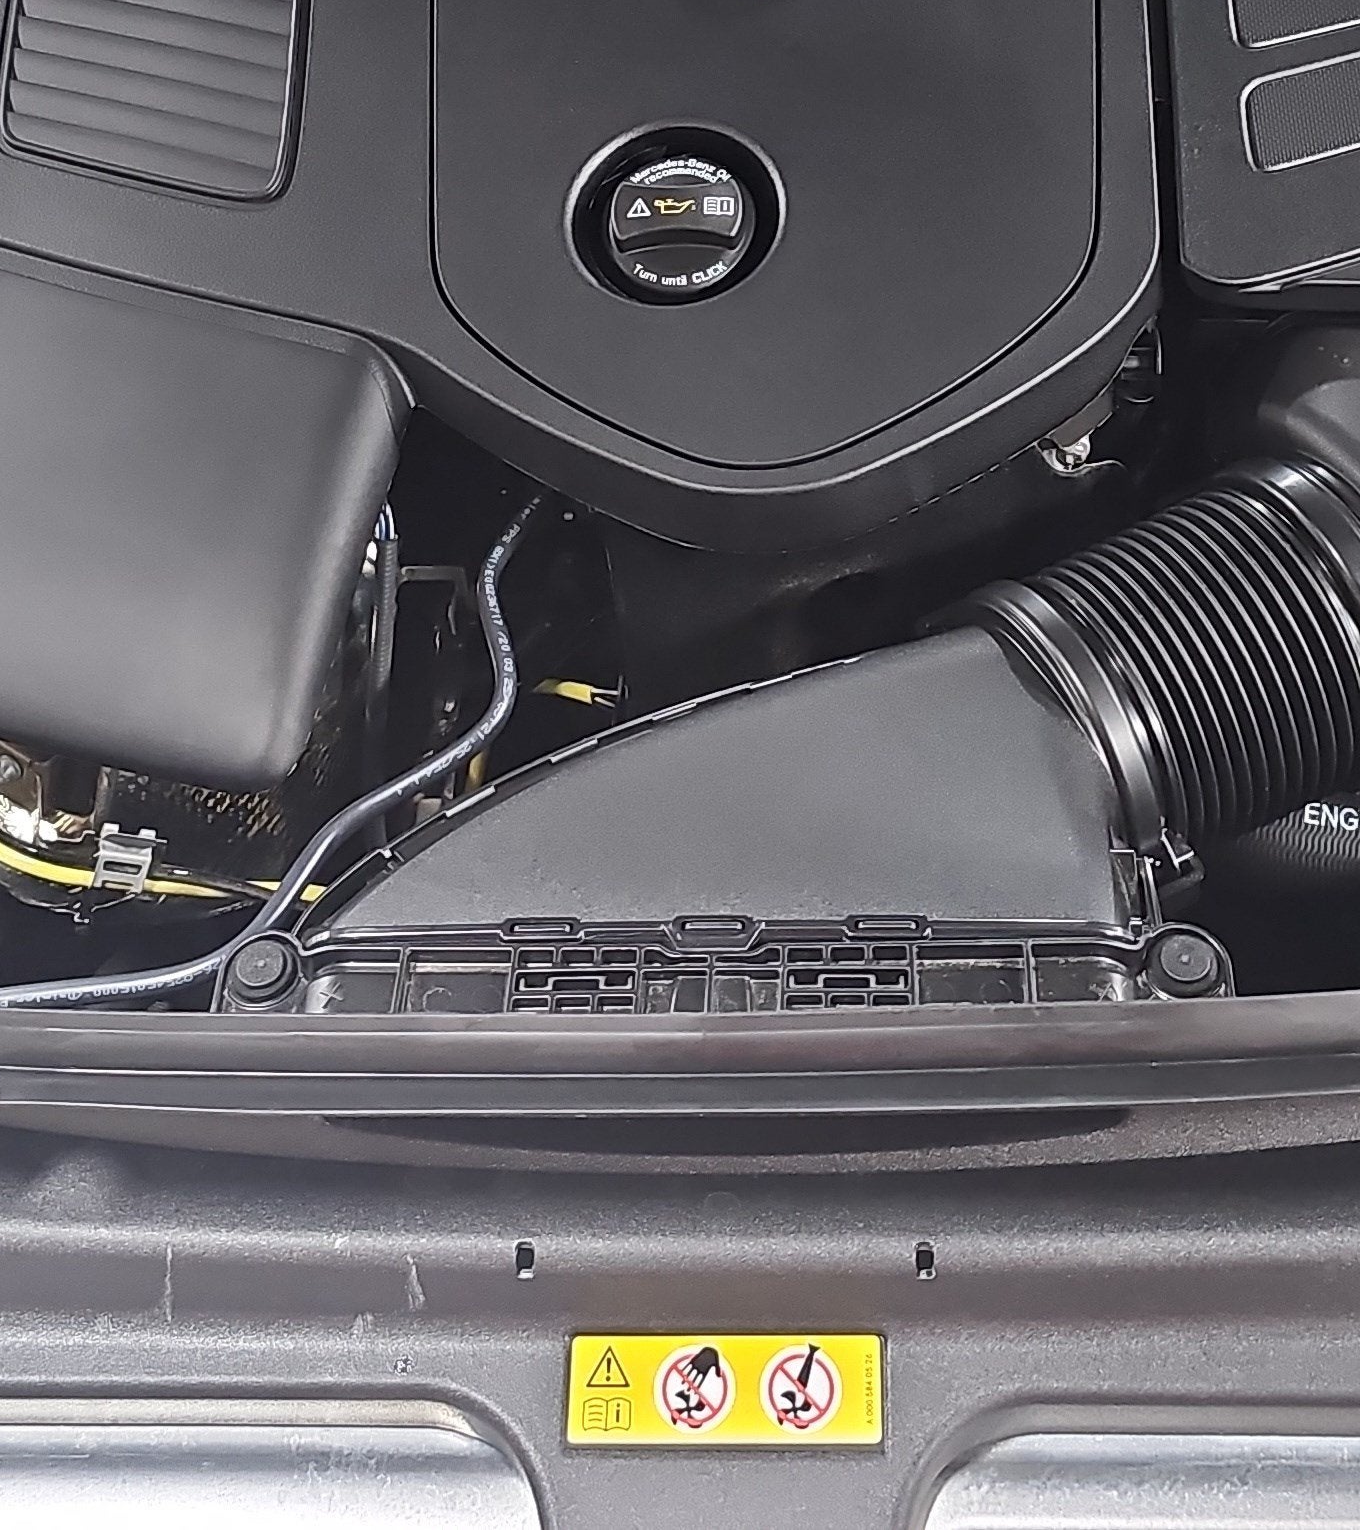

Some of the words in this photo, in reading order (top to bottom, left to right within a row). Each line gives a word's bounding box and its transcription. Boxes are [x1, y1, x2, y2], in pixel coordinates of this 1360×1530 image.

[630, 158, 717, 184] Mercedes-Benz
[643, 167, 720, 185] recommended
[632, 263, 658, 283] Turn
[661, 273, 687, 286] until
[692, 260, 728, 284] CLICK
[866, 1399, 874, 1417] 000
